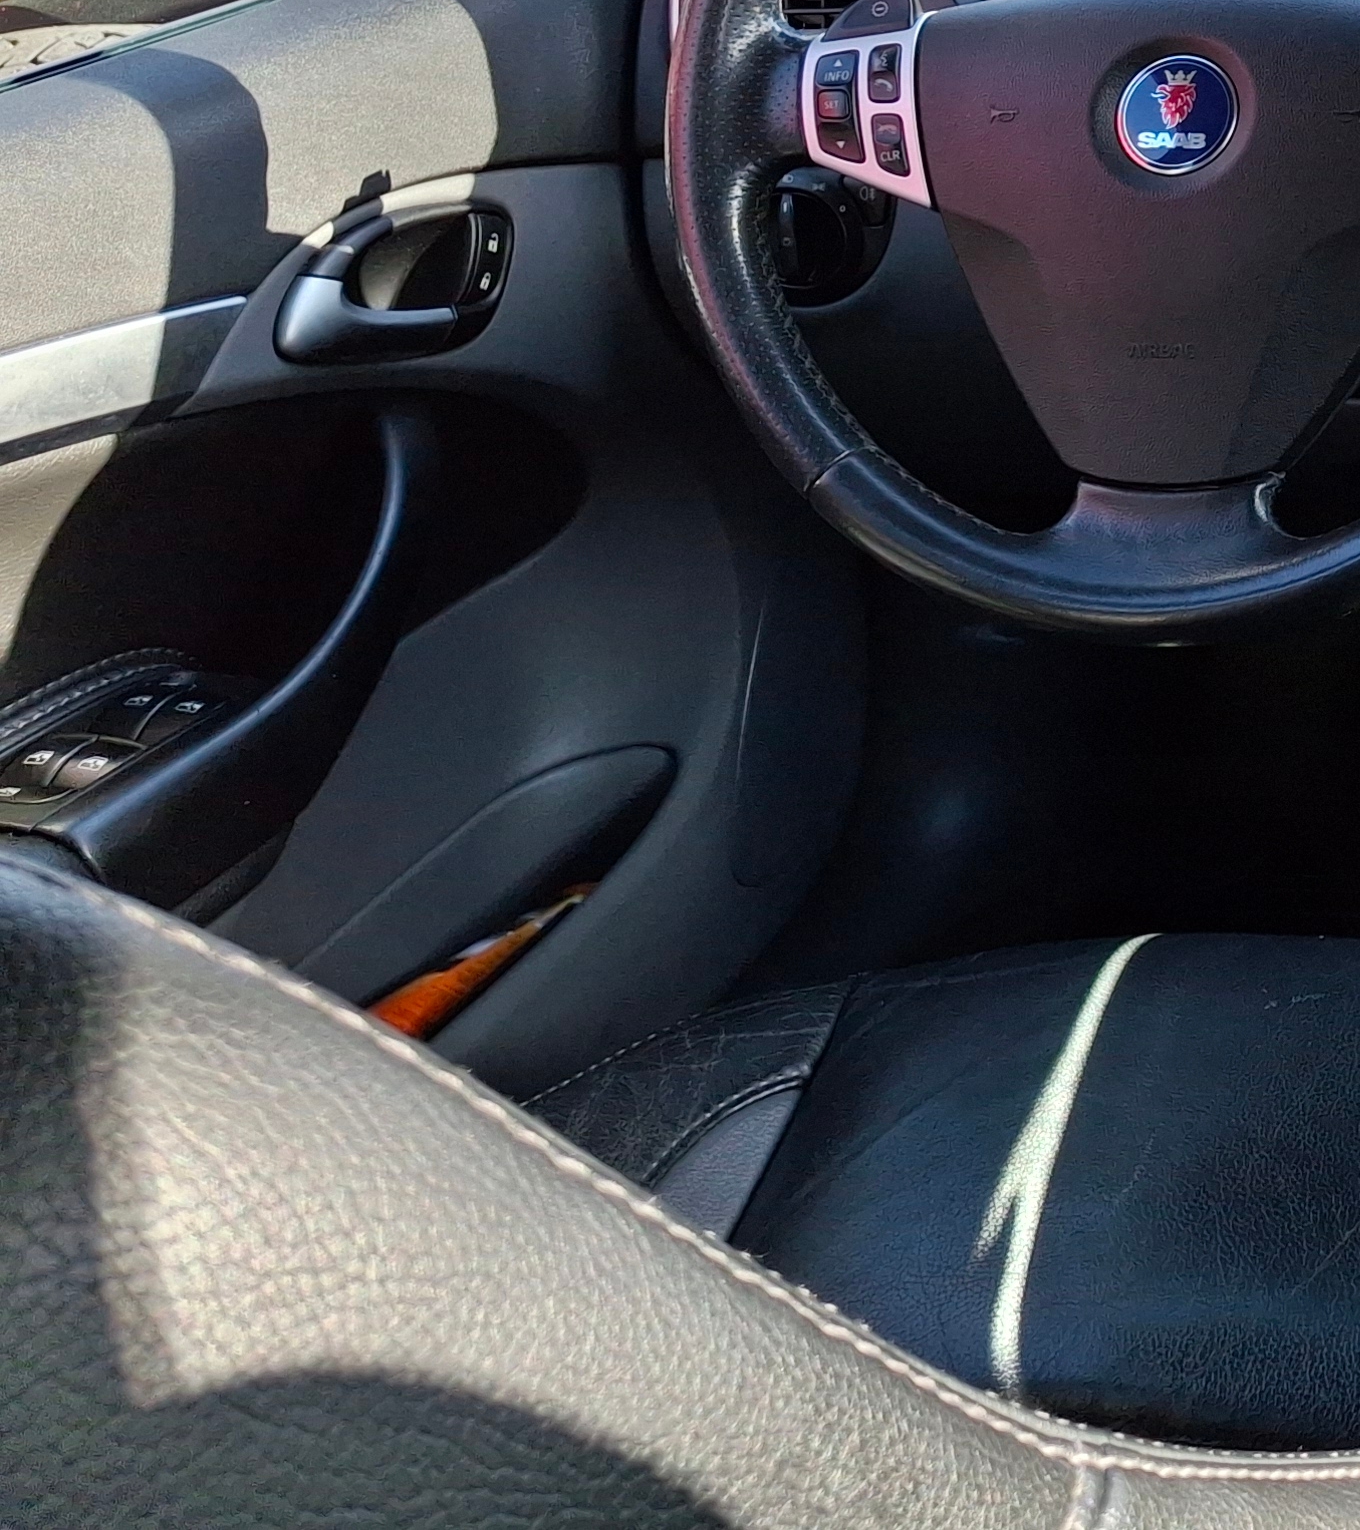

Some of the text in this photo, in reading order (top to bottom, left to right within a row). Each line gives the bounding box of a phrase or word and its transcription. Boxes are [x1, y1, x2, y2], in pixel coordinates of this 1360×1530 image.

[824, 70, 850, 82] INFO
[824, 100, 839, 110] SET
[1137, 131, 1206, 150] SAAB
[880, 150, 901, 162] CLR
